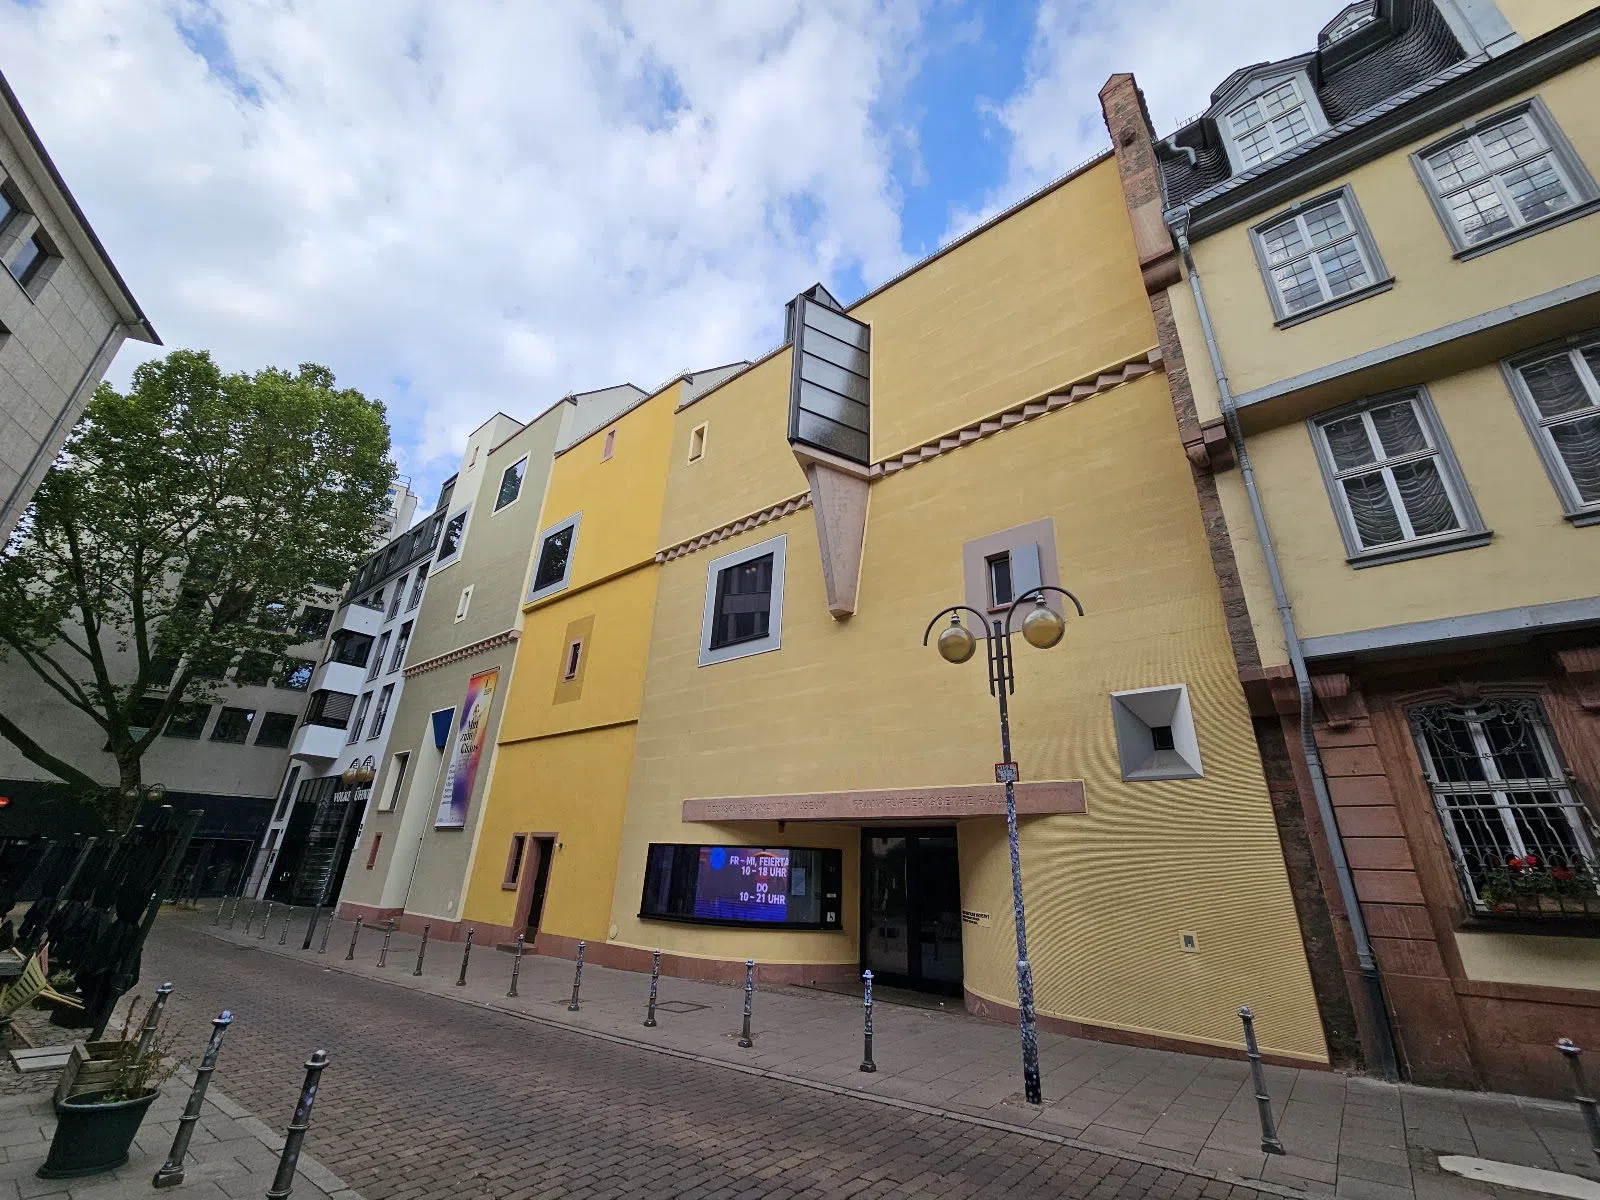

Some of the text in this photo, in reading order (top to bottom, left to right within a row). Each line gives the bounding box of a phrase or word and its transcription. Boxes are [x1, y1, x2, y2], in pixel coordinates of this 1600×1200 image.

[853, 798, 925, 809] FRANKFURTER
[928, 795, 974, 807] GOETHE
[729, 855, 739, 865] FR
[746, 856, 757, 867] MI,
[741, 866, 751, 876] 10
[758, 867, 768, 877] 18
[769, 867, 787, 878] UHR
[756, 882, 768, 893] DO
[739, 892, 749, 901] 10
[756, 893, 766, 903] 21
[767, 894, 786, 905] UHR
